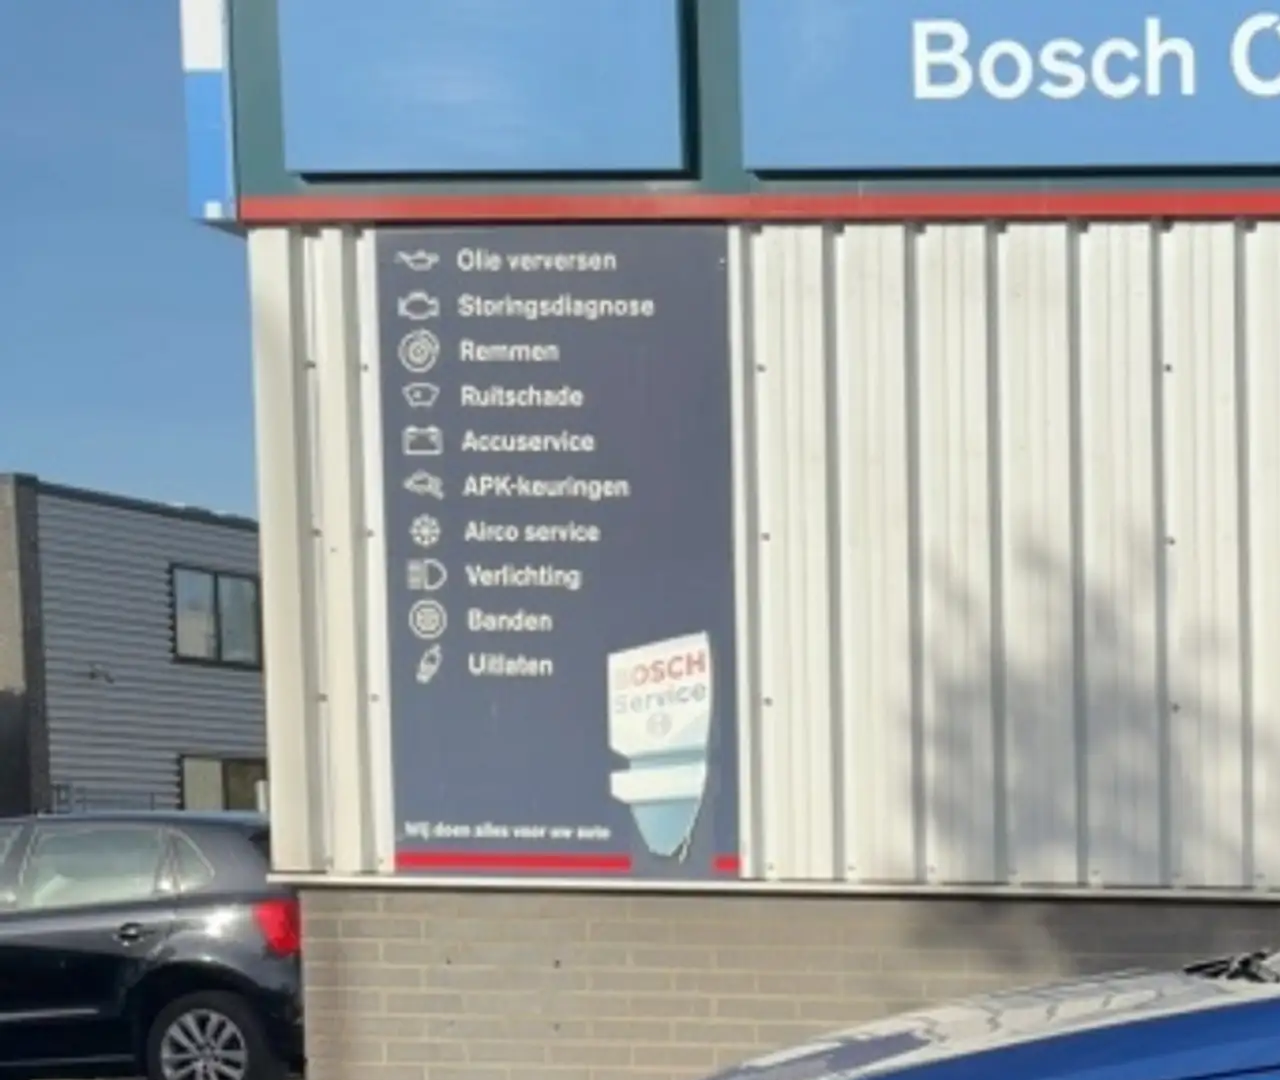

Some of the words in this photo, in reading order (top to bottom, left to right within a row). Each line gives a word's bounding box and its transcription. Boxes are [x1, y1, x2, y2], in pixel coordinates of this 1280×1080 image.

[912, 17, 1195, 99] Bosch
[456, 248, 502, 271] Olie
[506, 253, 617, 271] verversen
[457, 293, 655, 320] Storingsdiagnose
[459, 338, 560, 361] Remmen
[460, 384, 584, 407] Ruitschade
[461, 430, 595, 451] Accuservice
[462, 474, 630, 500] APK-keuringen
[464, 520, 520, 541] Airco
[524, 521, 601, 541] service
[464, 564, 582, 591] Verlichting
[467, 608, 553, 631] Banden
